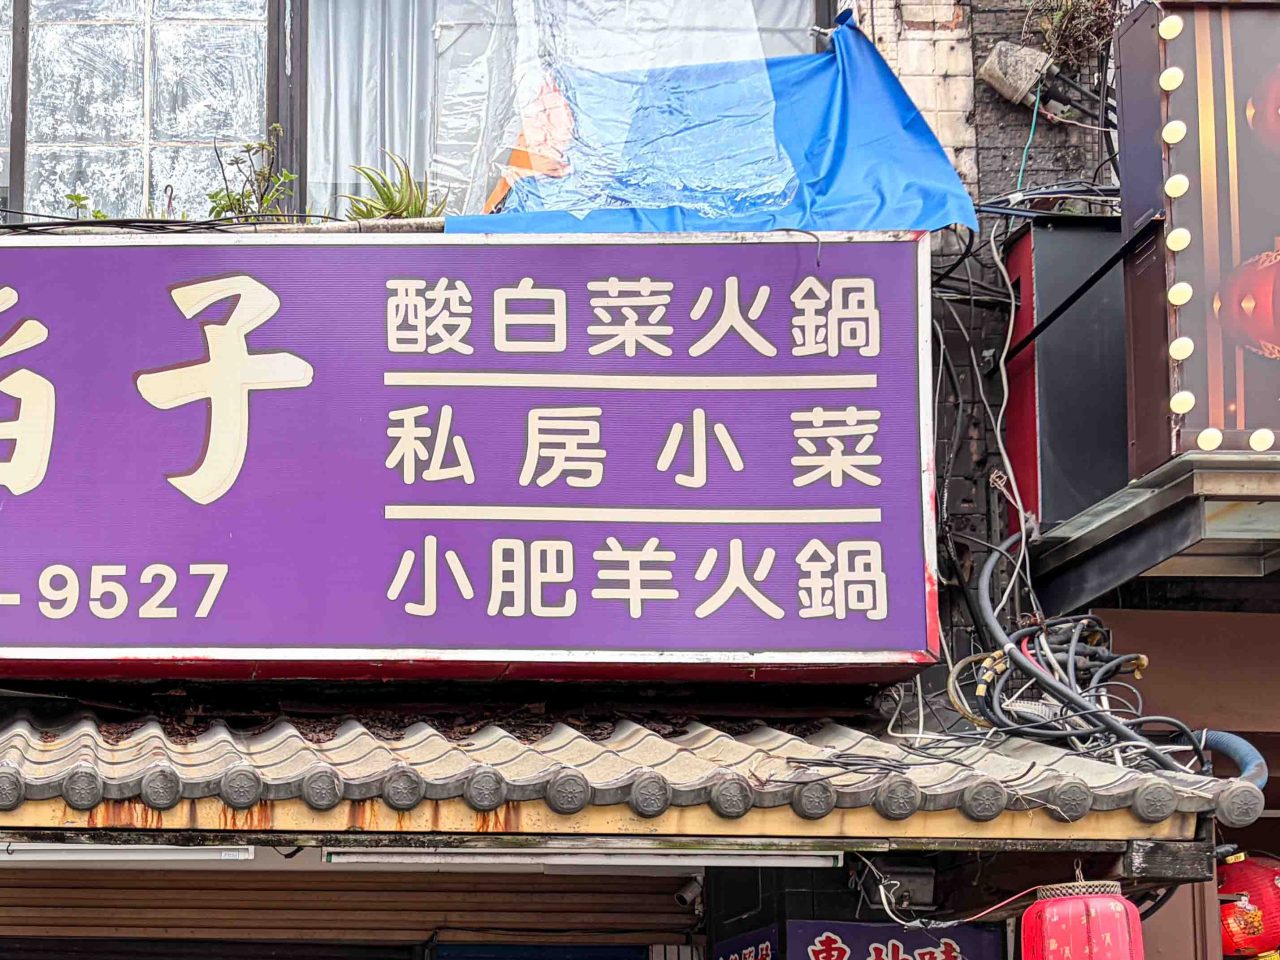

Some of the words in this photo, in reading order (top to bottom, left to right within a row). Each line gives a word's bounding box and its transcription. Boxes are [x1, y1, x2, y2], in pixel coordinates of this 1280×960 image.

[385, 276, 881, 358] 酸白菜火鍋
[385, 405, 883, 488] 私房小菜
[386, 534, 888, 620] 小肥羊火鍋
